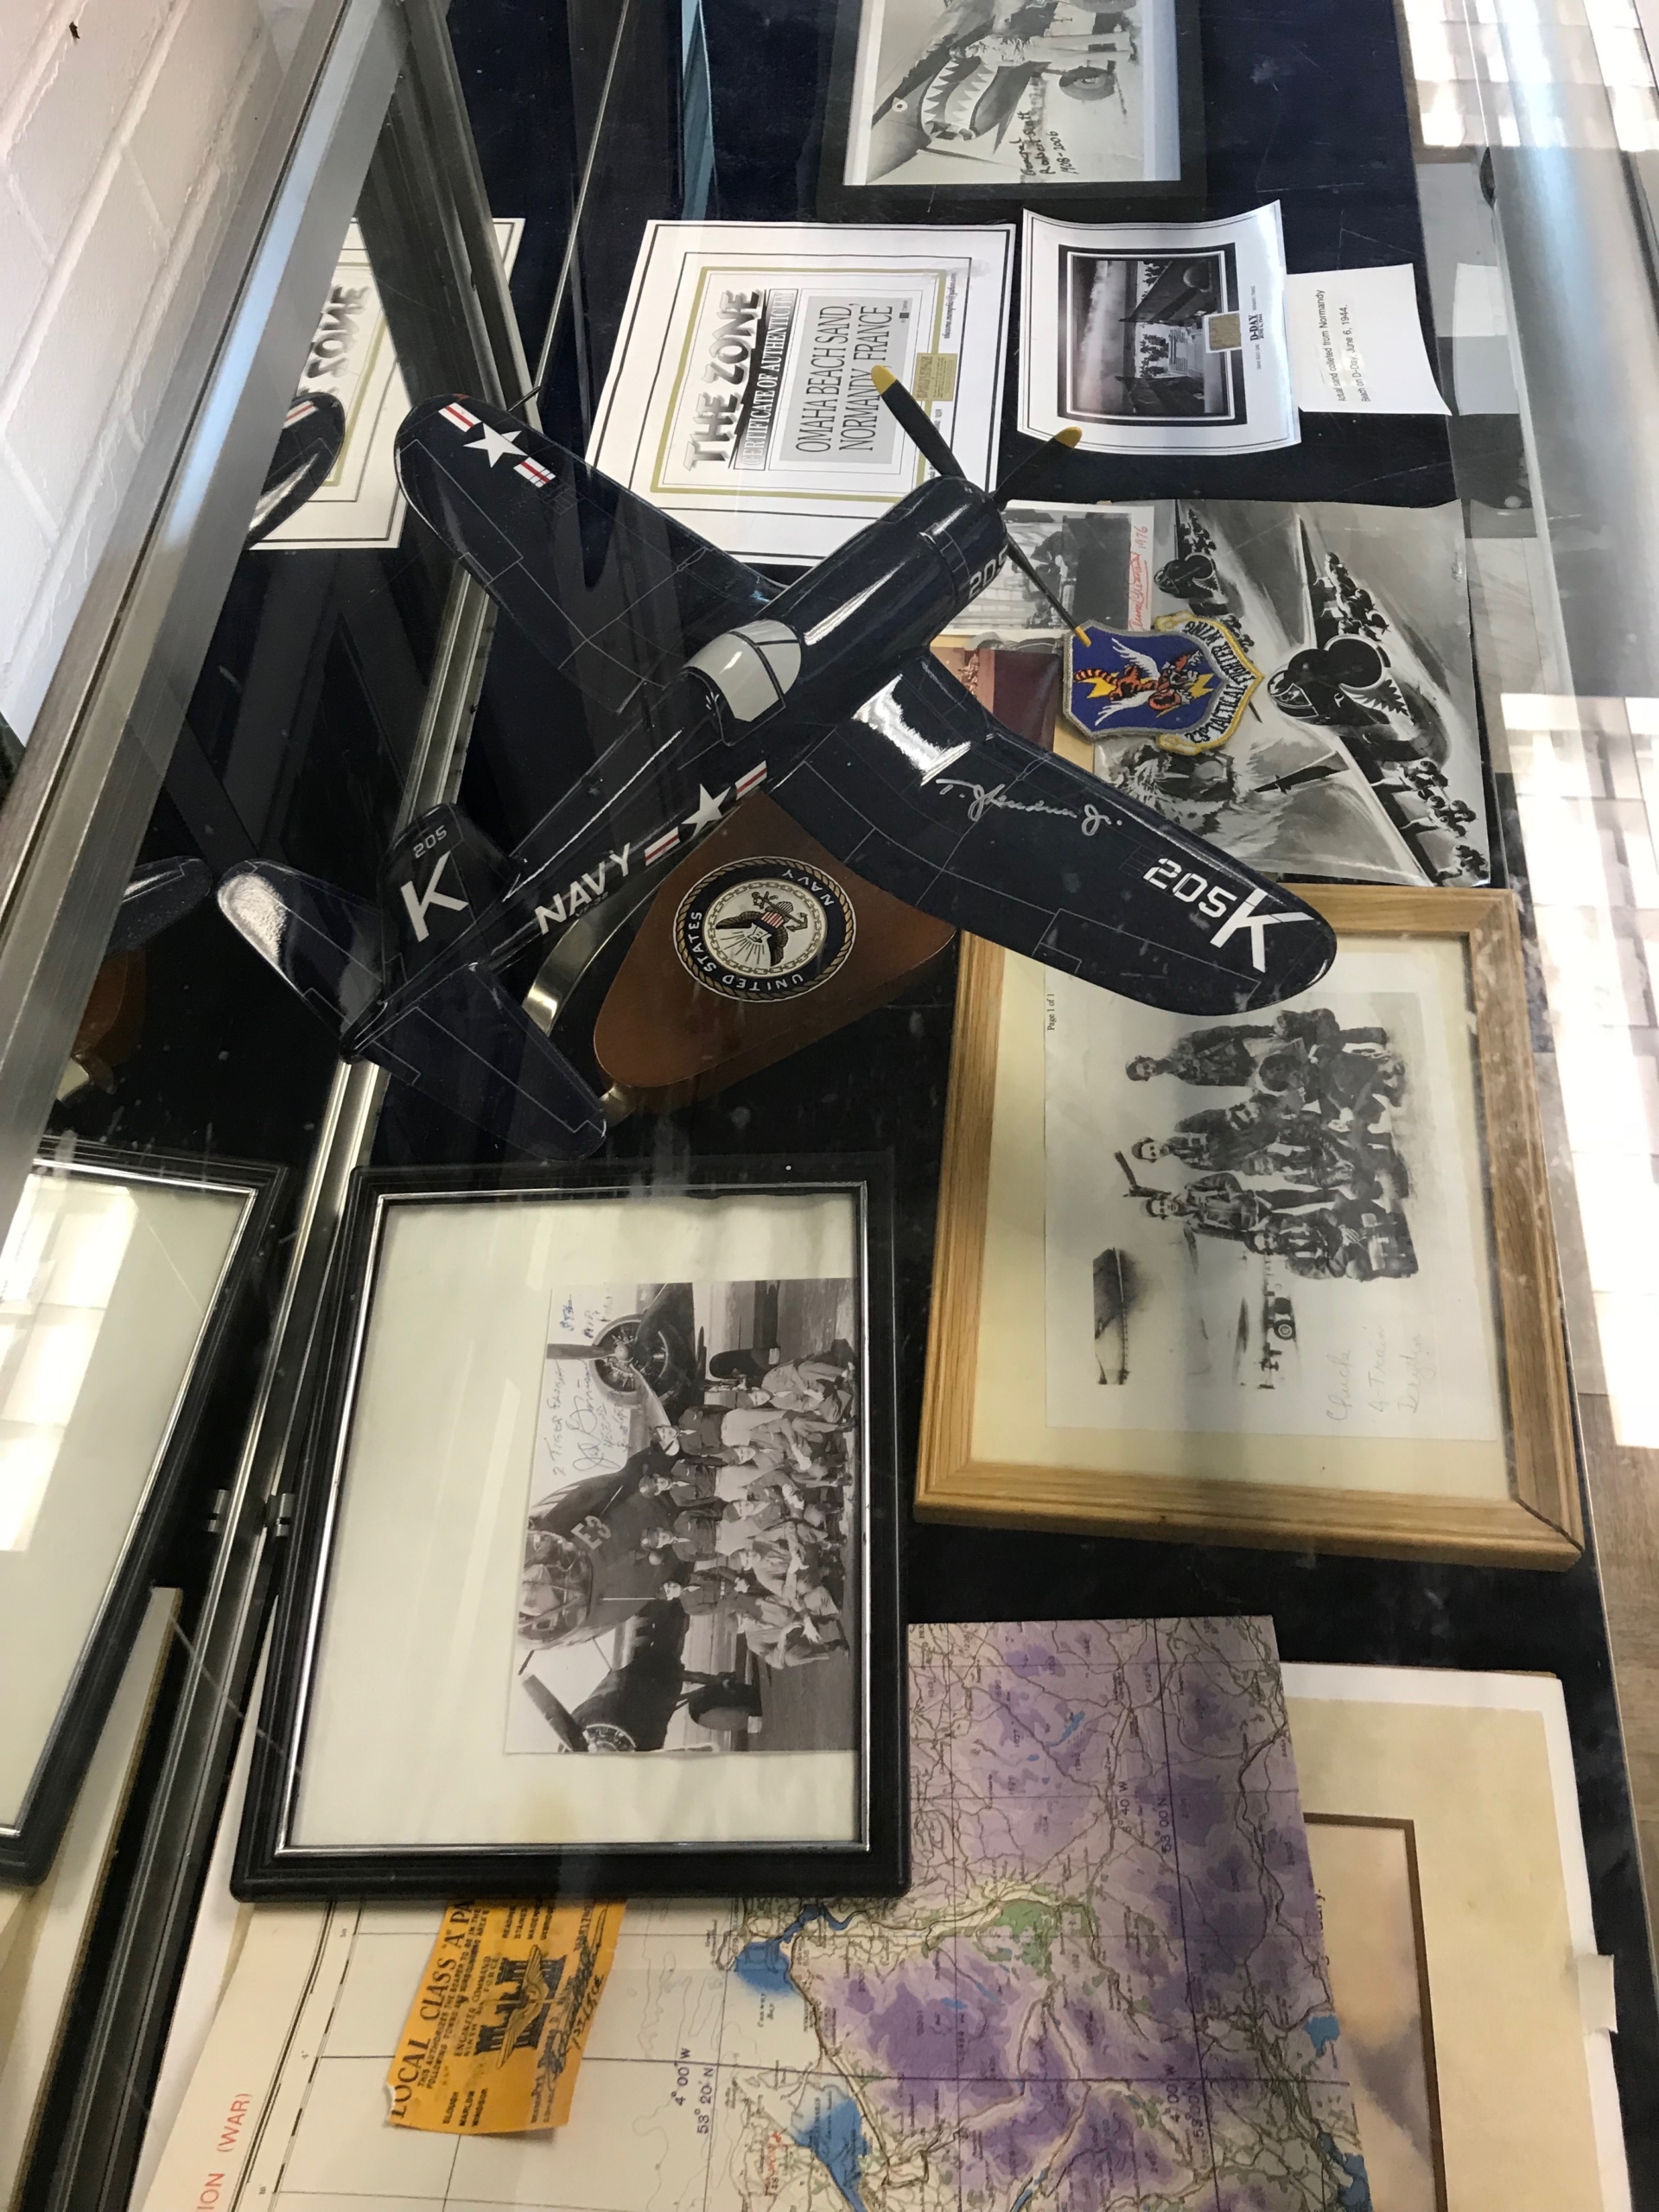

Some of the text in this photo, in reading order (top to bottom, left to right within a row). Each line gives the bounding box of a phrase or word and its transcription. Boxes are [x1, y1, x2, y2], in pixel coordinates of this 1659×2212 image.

[1249, 314, 1260, 341] D-DAY
[1339, 304, 1350, 326] 1944.
[853, 306, 893, 360] FRANCE
[1315, 289, 1346, 402] Actual sand colleted from Normandy
[1344, 337, 1355, 353] June
[683, 290, 759, 472] THE ZONE
[741, 291, 793, 466] CERTIFICATE OF AUTHENTICITY
[795, 303, 859, 453] OMAHA BEACH SAND,
[1357, 388, 1370, 402] Beach
[1134, 525, 1147, 549] 1976
[1182, 620, 1224, 646] WING
[1211, 641, 1256, 684] FIGHTER
[1208, 684, 1248, 734] TACTICAL
[413, 824, 448, 859] 205
[400, 850, 469, 943] K
[534, 842, 632, 936] NAVY
[687, 868, 835, 992] UNITED STATES NAVY
[1142, 858, 1315, 974] 205 K
[1046, 998, 1055, 1007] of
[1046, 1014, 1057, 1031] Page
[570, 1515, 612, 1550] E3
[1118, 1781, 1128, 1792] W
[1156, 1797, 1168, 1806] N
[467, 1926, 476, 1936] IN
[469, 1908, 480, 1923] THE
[460, 1951, 469, 1961] TO
[471, 1955, 491, 2003] COMMAND
[483, 1957, 499, 1993] FORCE
[390, 2038, 430, 2120] LOCAL
[420, 1958, 456, 2020] CLASS
[448, 1899, 476, 1924] PA
[443, 1994, 455, 2008] THE
[425, 2012, 448, 2065] AUTHORIZES
[679, 2047, 691, 2060] W
[417, 2069, 430, 2087] THIS
[426, 2044, 448, 2089] FOLLOWING
[702, 2067, 715, 2077] N
[196, 2094, 253, 2209] ION (WAR)
